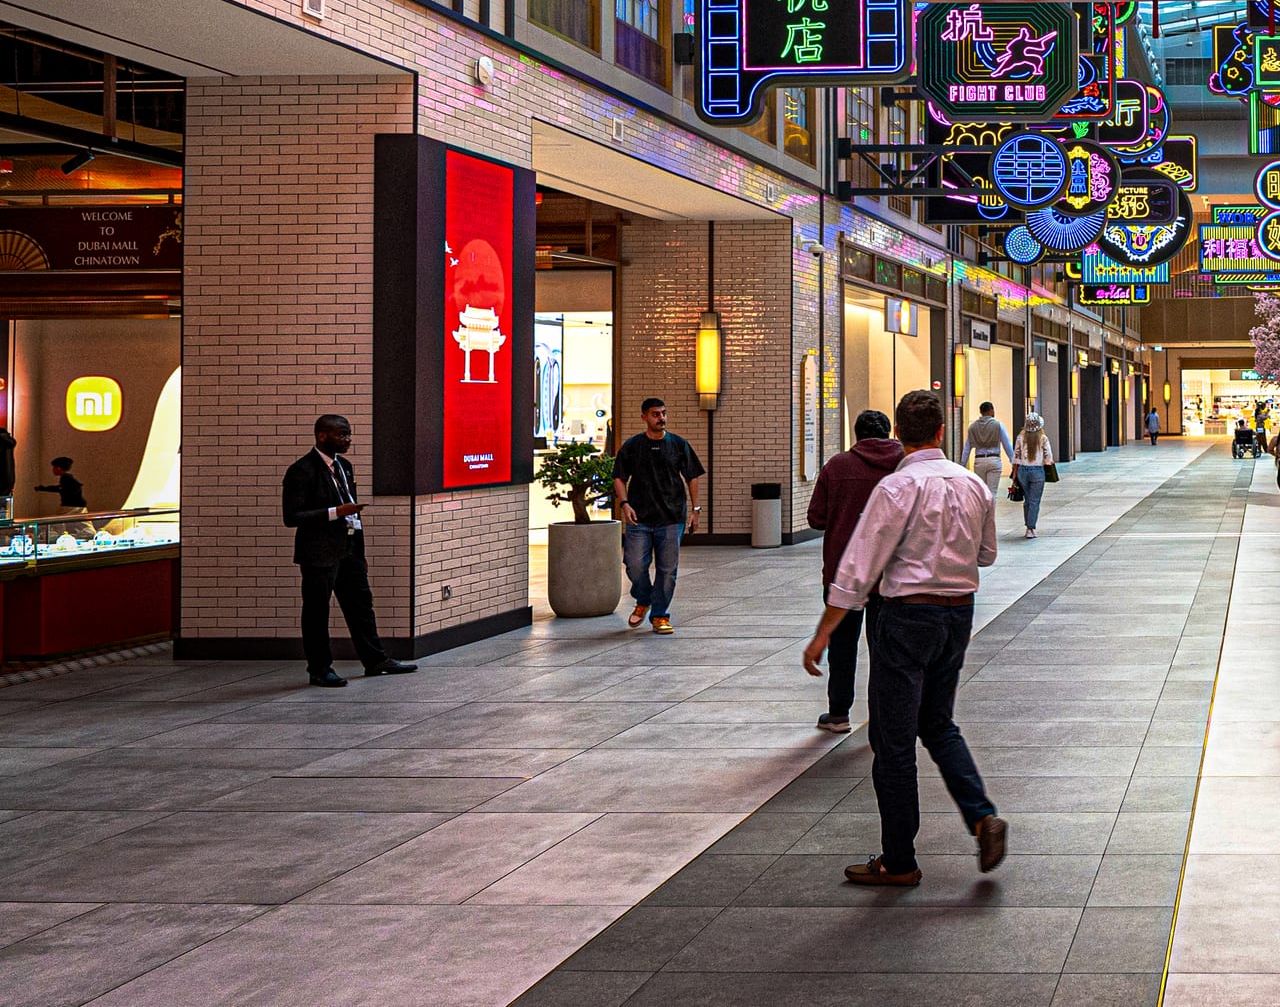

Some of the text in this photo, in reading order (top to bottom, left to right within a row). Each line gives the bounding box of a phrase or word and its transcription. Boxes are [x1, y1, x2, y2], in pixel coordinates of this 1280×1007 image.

[940, 3, 995, 42] 抗
[949, 84, 1046, 102] FIGHT CLUB
[81, 211, 133, 221] WELCOME
[100, 226, 115, 236] TO
[78, 241, 139, 251] DUBAI MALL
[74, 256, 140, 266] CHINATOWN
